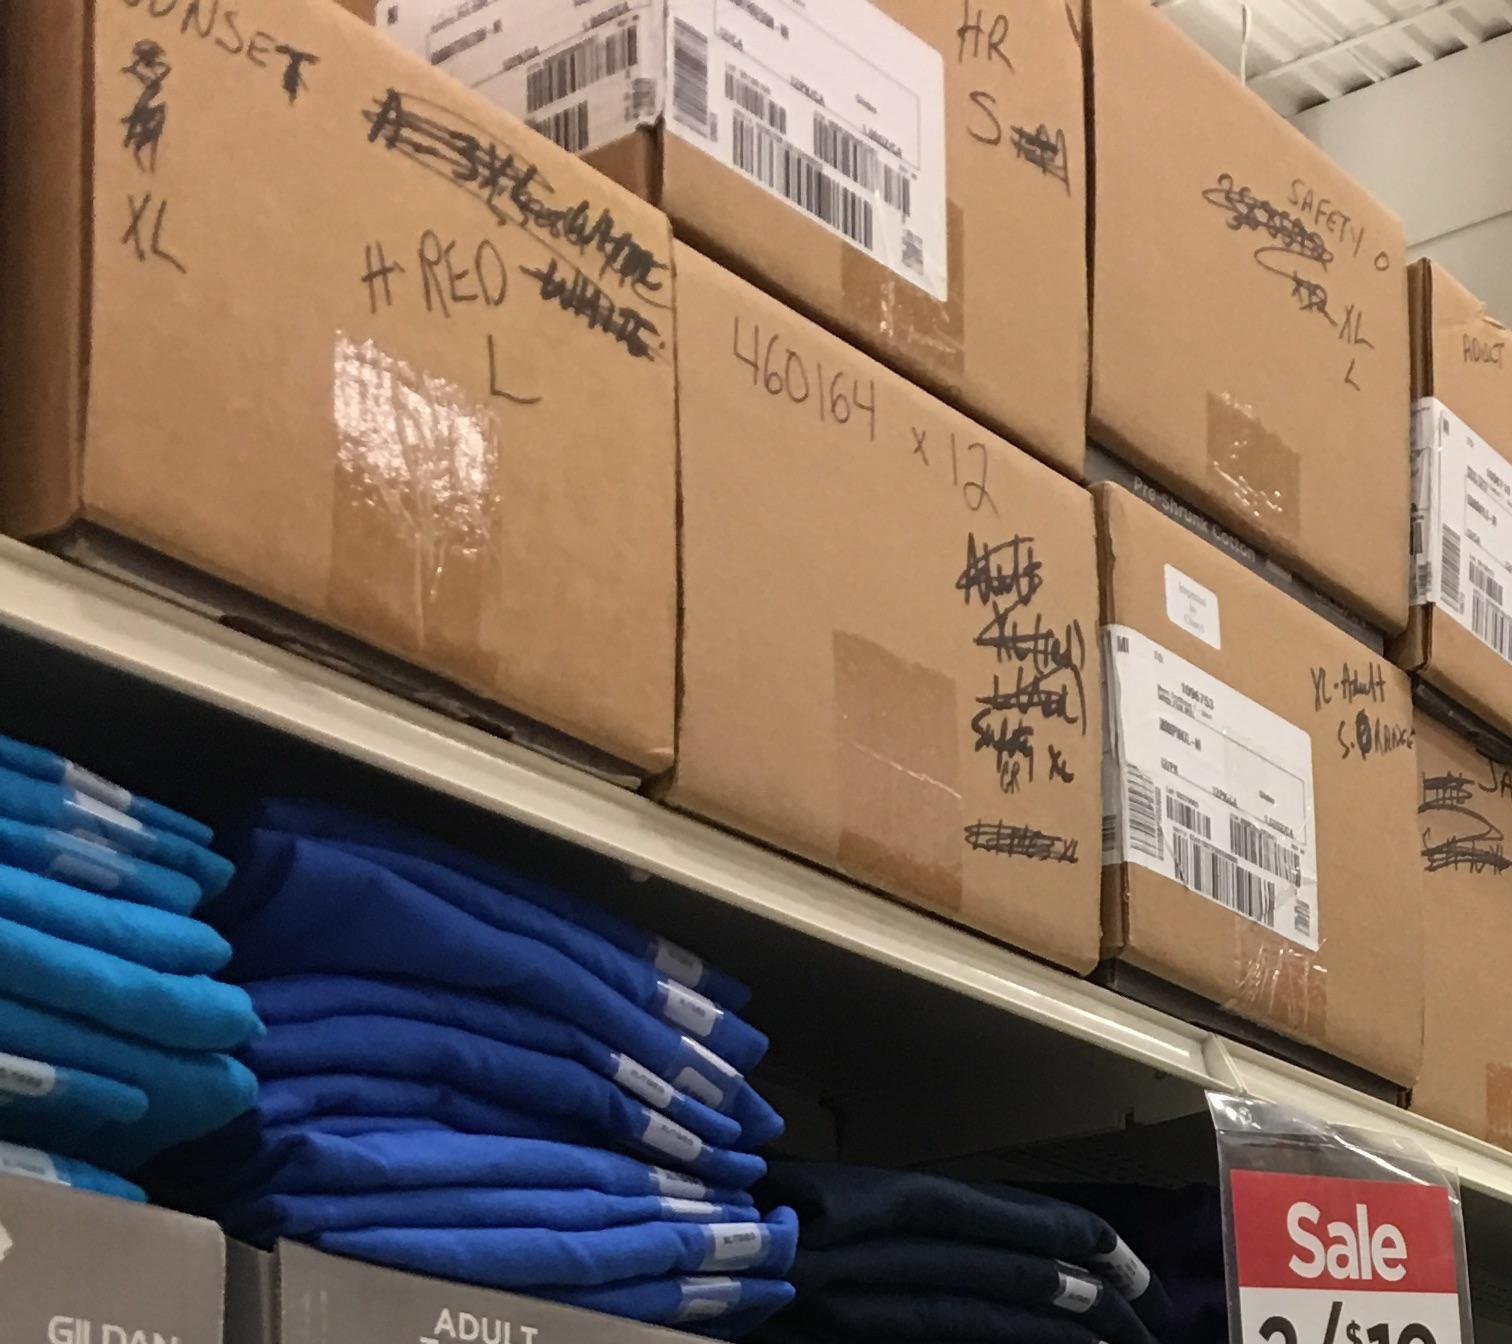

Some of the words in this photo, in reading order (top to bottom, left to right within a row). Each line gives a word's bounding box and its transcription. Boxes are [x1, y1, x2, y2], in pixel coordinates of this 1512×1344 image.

[122, 0, 320, 106] NSET
[123, 191, 187, 274] XL
[1287, 178, 1365, 257] SAFETY
[419, 229, 508, 318] RED
[1337, 303, 1375, 350] XL
[488, 333, 541, 404] L
[733, 314, 876, 442] 460164
[950, 431, 998, 516] 12
[1132, 475, 1209, 535] Pre-Shrunk
[1212, 523, 1257, 563] Cotton
[1286, 1201, 1408, 1282] Sale
